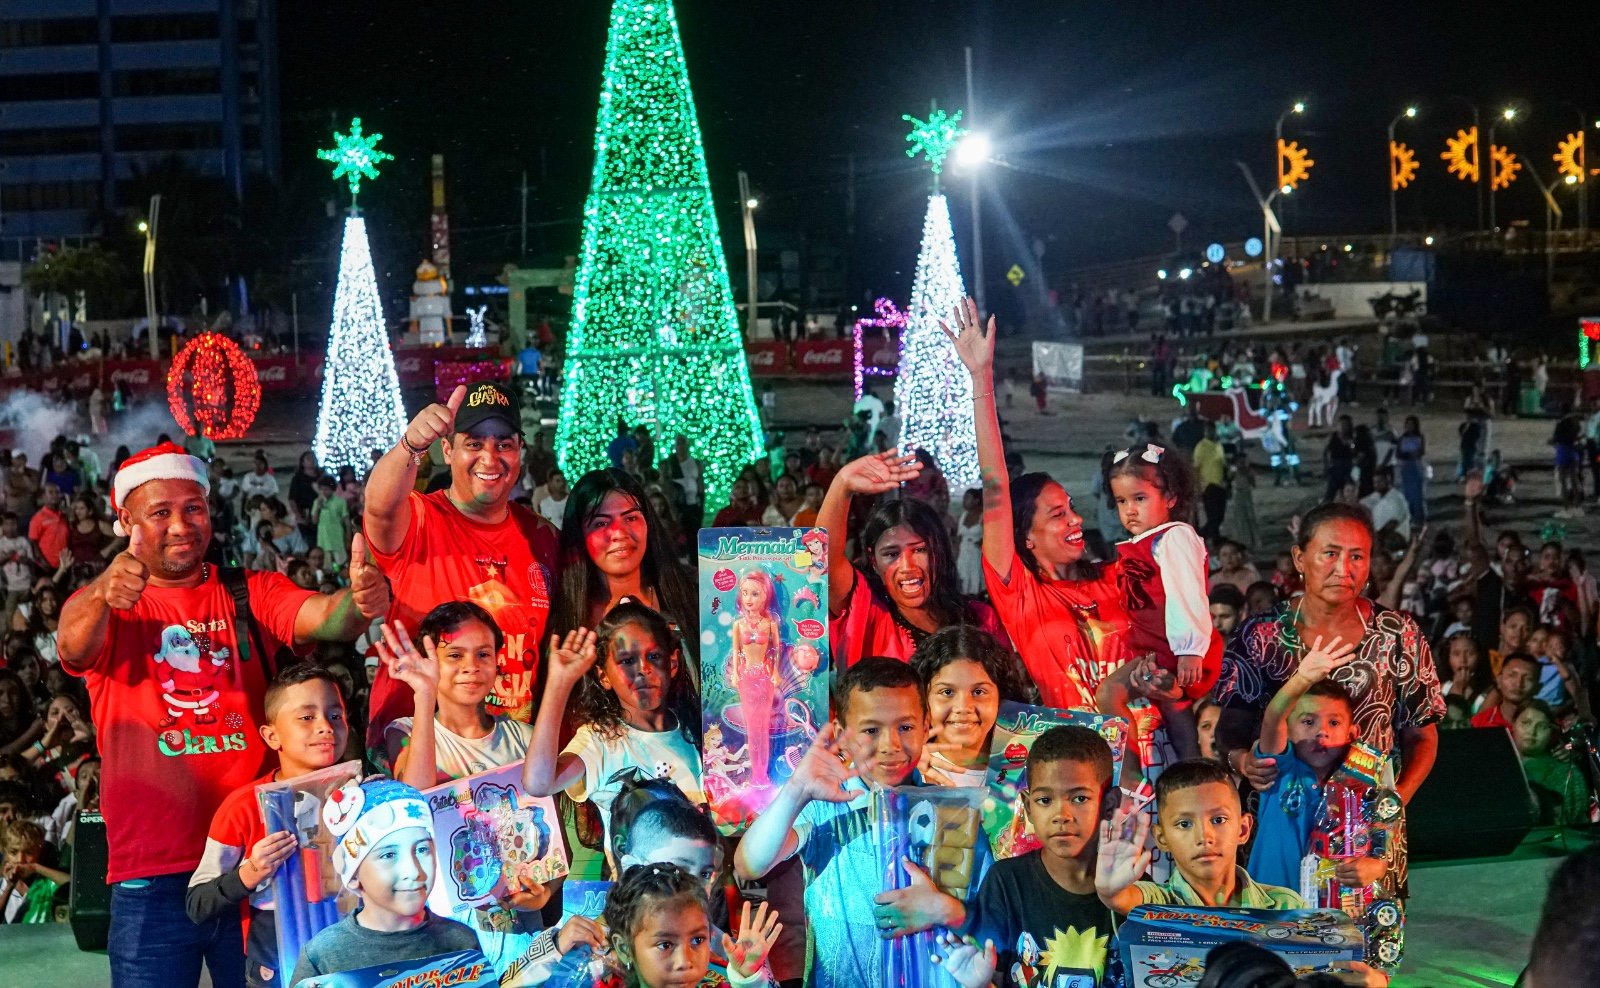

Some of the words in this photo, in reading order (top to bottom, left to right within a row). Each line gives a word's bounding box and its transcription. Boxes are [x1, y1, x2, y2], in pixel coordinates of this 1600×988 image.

[711, 537, 798, 560] Mermaid
[158, 728, 248, 757] Claus
[1142, 911, 1222, 921] MOTOR
[1192, 919, 1266, 933] CYCLE
